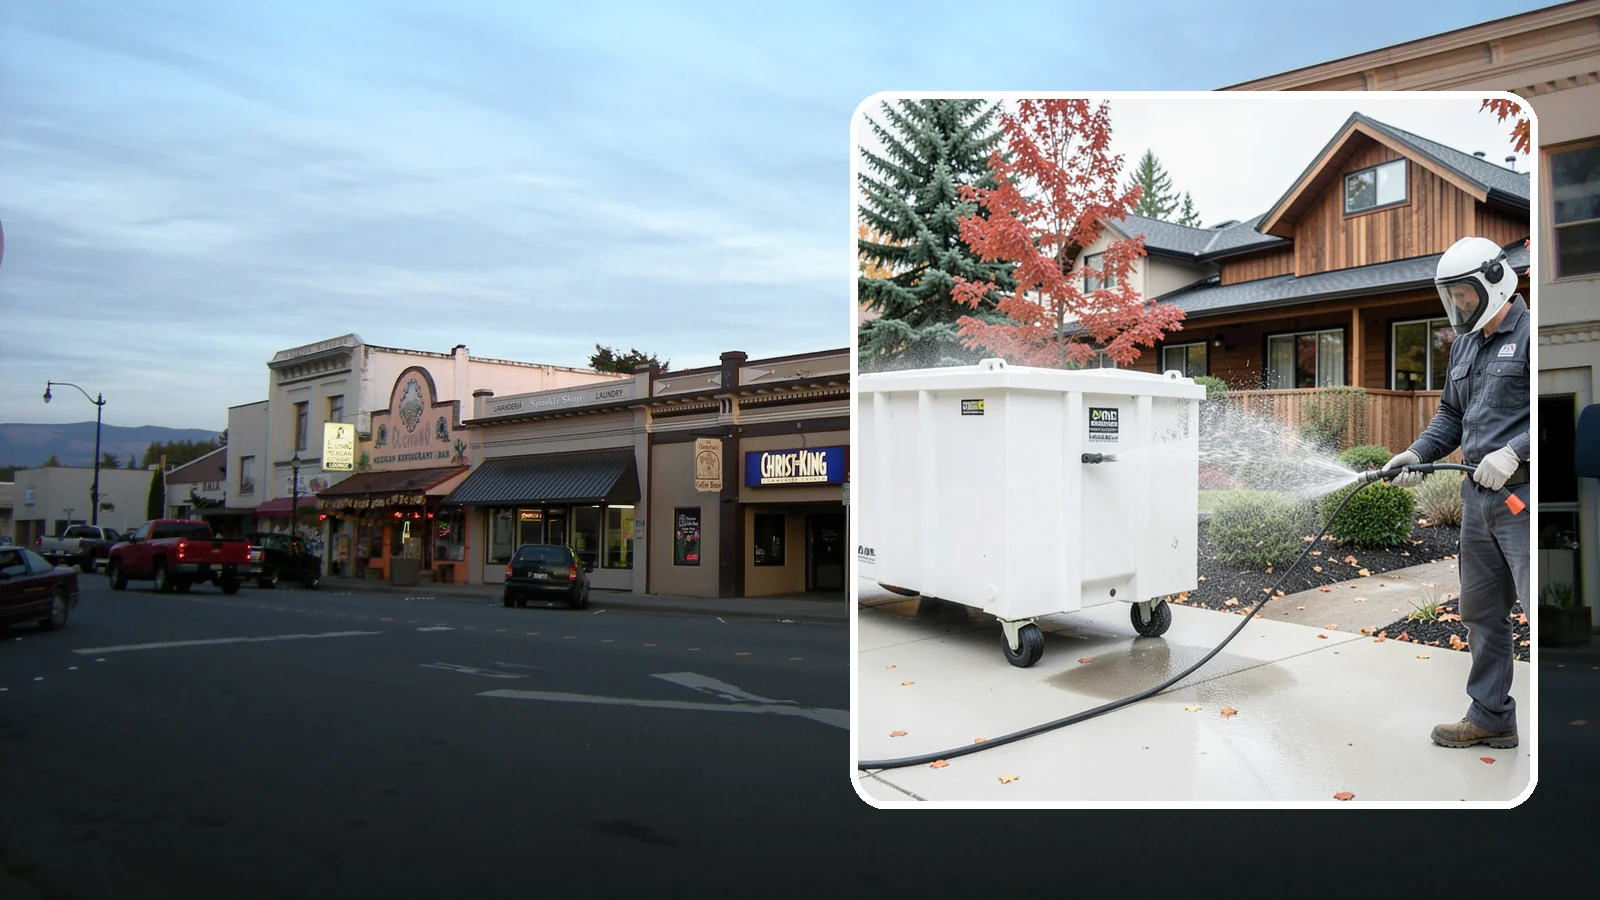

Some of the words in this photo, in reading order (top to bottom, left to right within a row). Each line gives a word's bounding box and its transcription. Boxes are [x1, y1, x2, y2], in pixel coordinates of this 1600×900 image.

[493, 402, 522, 412] LAVANDERIA
[595, 389, 623, 399] LAUNDRY
[373, 455, 396, 464] MEXICAN
[397, 451, 433, 462] RESTAURANT
[438, 450, 450, 459] BAR
[761, 452, 797, 478] CHRIST
[799, 450, 827, 476] KING
